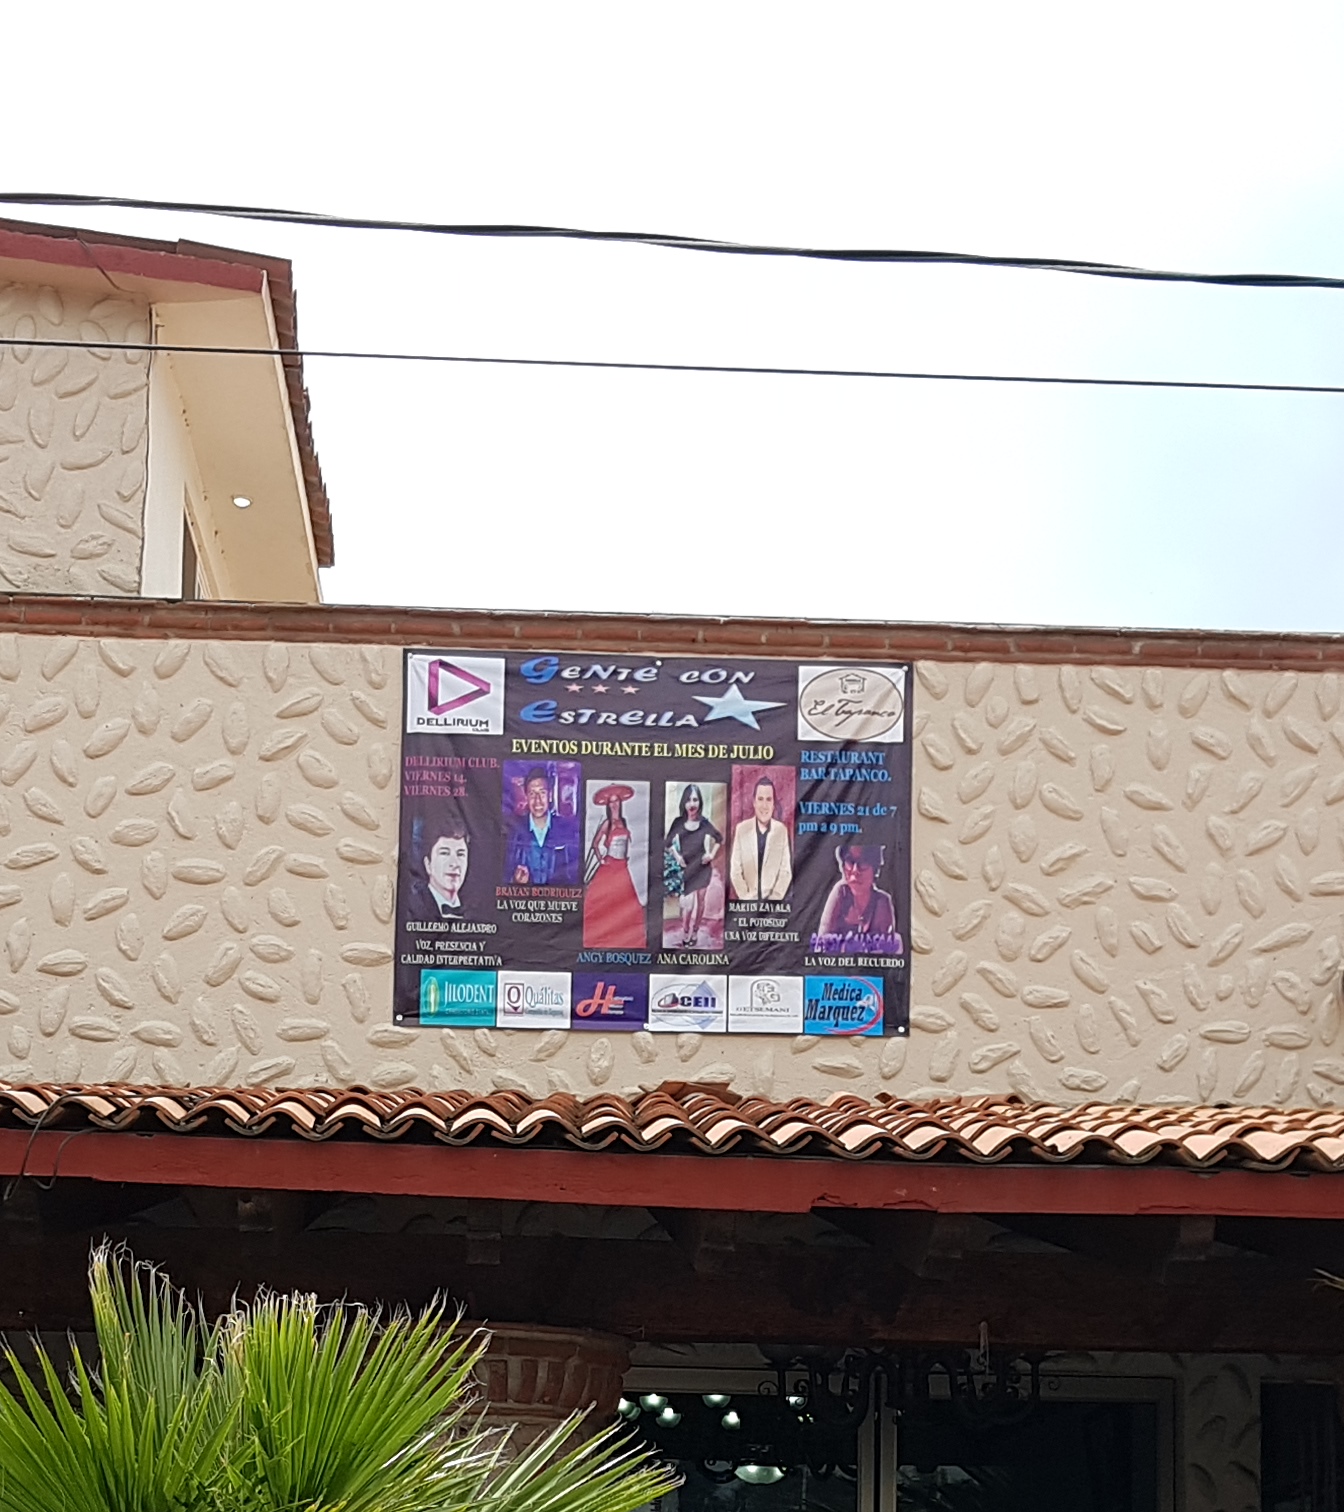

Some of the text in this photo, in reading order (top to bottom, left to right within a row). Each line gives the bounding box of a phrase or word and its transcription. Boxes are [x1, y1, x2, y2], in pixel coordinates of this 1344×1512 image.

[808, 699, 835, 716] El
[416, 717, 489, 727] DELLIRIUM
[512, 738, 774, 760] EVENTOS DURANTE EL MES DE JULIO
[405, 756, 500, 768] DELLIRIUM CLUB.
[800, 750, 885, 765] RESTAURANT
[404, 770, 451, 782] VIERNES
[800, 768, 892, 782] BAR TAPANCO.
[404, 785, 468, 797] VIERNES 28.
[799, 802, 897, 817] VIERNES 21 de 7
[798, 822, 862, 835] pm a 9 pm.
[496, 886, 582, 898] BRAYAN RODRIGUEZ
[497, 900, 578, 911] LA VOZ QUE MUEVE
[512, 912, 563, 923] CORAZONES
[406, 921, 497, 934] GUILLERMO ALEJANDRO
[724, 930, 800, 942] UNA VOZ DIFERENTE
[416, 939, 486, 952] VOZ, PRESENCIA Y
[401, 954, 503, 966] CALIDAD INTERPRETATIVA
[576, 952, 652, 966] ANGY BOSQUEZ
[657, 953, 730, 965] ANA CAROLINA
[804, 957, 905, 968] LA VOZ DEL RECUERDO
[444, 981, 495, 1007] JILODENT
[524, 984, 564, 1008] Quálitas
[821, 982, 863, 1002] Medica
[806, 998, 866, 1028] Marquez
